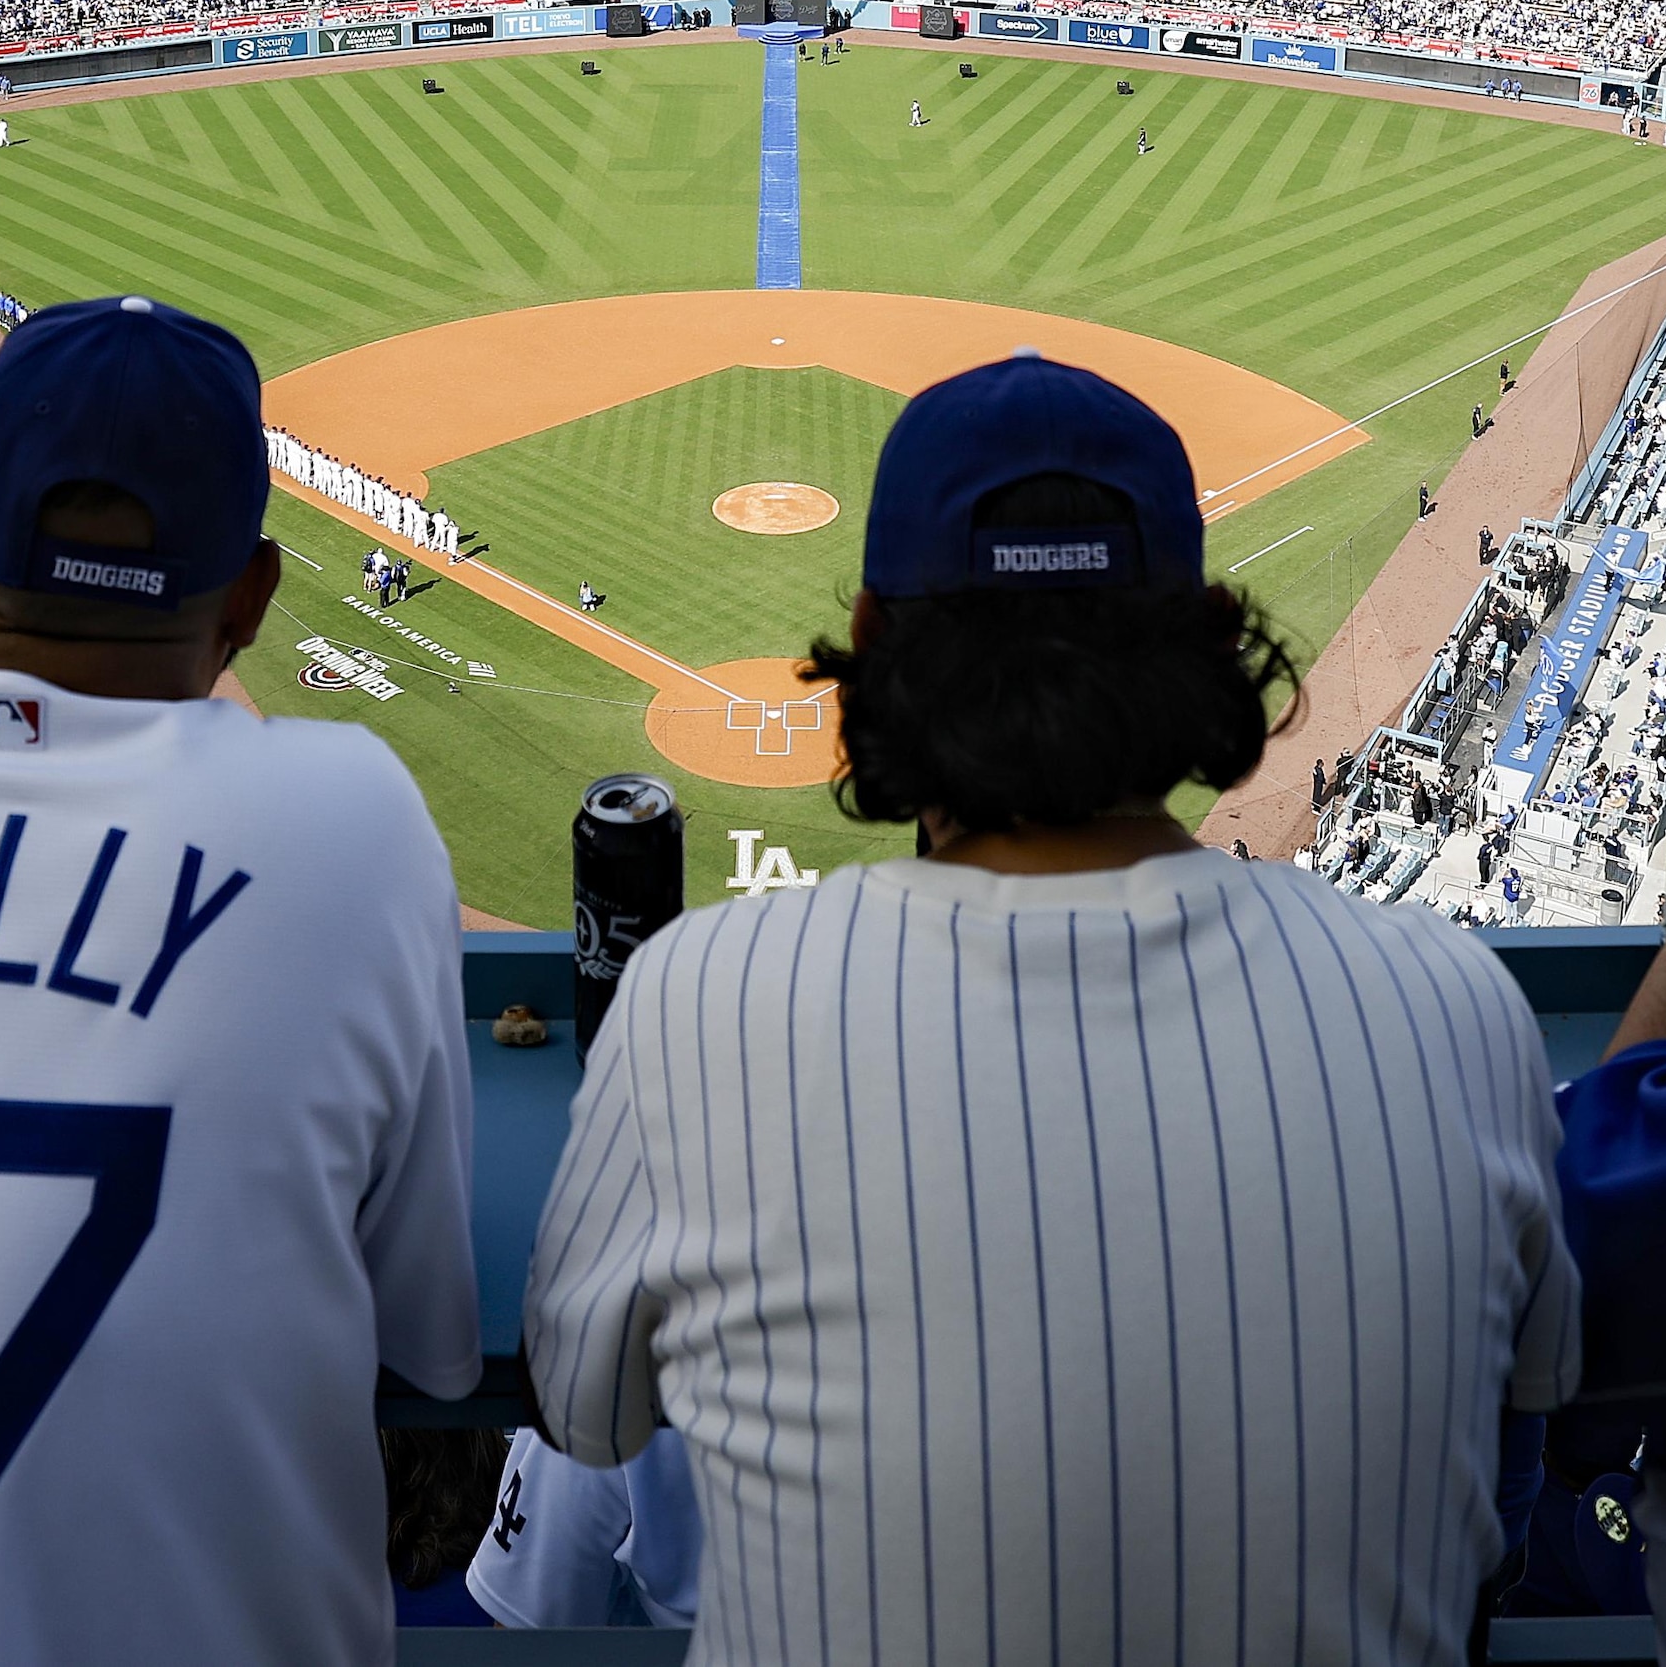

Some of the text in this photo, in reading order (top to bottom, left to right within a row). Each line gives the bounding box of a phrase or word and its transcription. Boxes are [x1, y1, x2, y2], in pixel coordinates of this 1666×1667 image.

[422, 22, 488, 36] UCLA Health
[505, 15, 544, 36] TEL
[549, 19, 583, 28] ELECTRON
[996, 18, 1039, 32] Spectrum
[1087, 24, 1118, 40] blue
[256, 36, 294, 50] Security
[257, 46, 290, 58] Benefit
[1267, 54, 1320, 70] Budweiser
[1582, 88, 1598, 97] 76
[991, 541, 1109, 572] DODGERS
[51, 555, 166, 596] DODGERS
[1575, 572, 1612, 636] STADIUM
[341, 595, 463, 665] BANK OF AMERICA
[295, 635, 366, 680] OPENING
[349, 668, 406, 702] WEEK
[725, 828, 820, 898] LA
